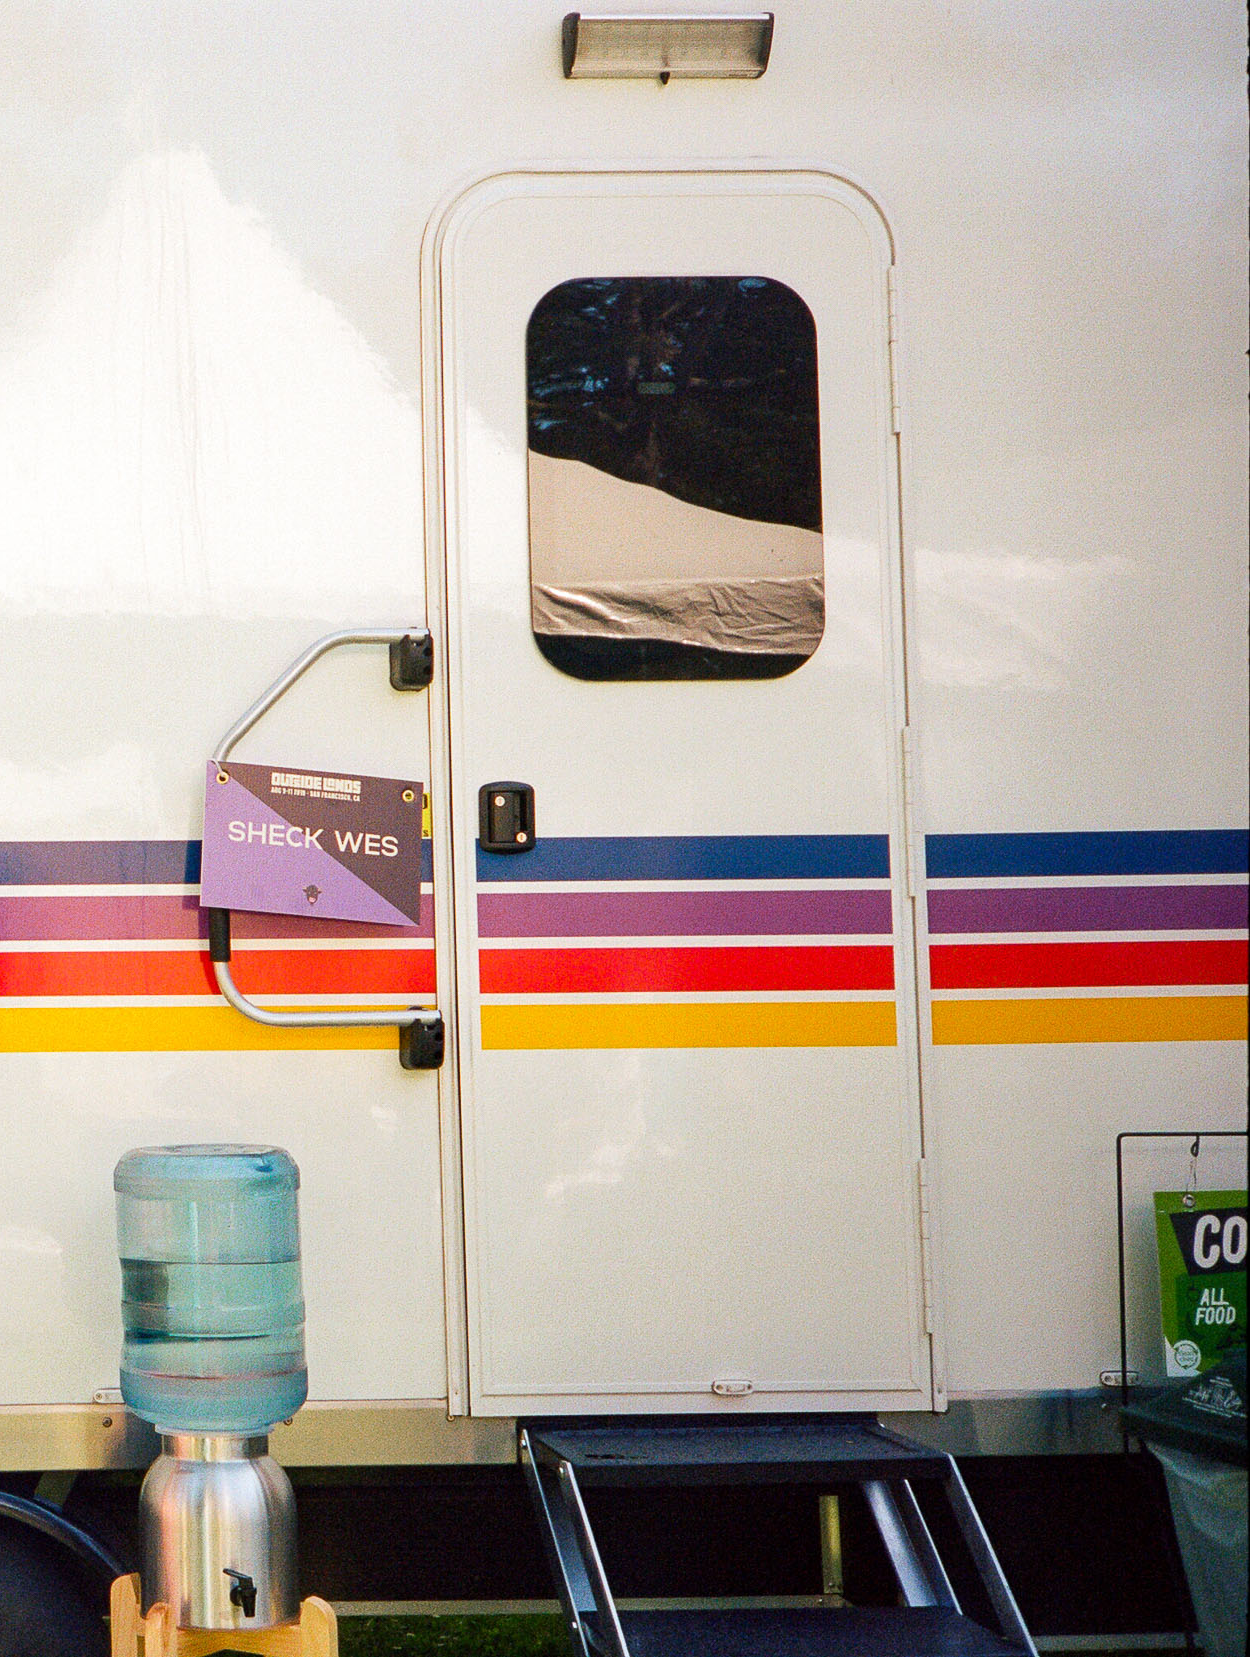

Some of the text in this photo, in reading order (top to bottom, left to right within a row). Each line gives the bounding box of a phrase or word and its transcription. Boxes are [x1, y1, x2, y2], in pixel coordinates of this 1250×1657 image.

[271, 772, 323, 791] OUTSIDE
[228, 820, 399, 857] SHECK WES
[1200, 1287, 1230, 1306] ALL
[1195, 1306, 1237, 1326] FOOD
